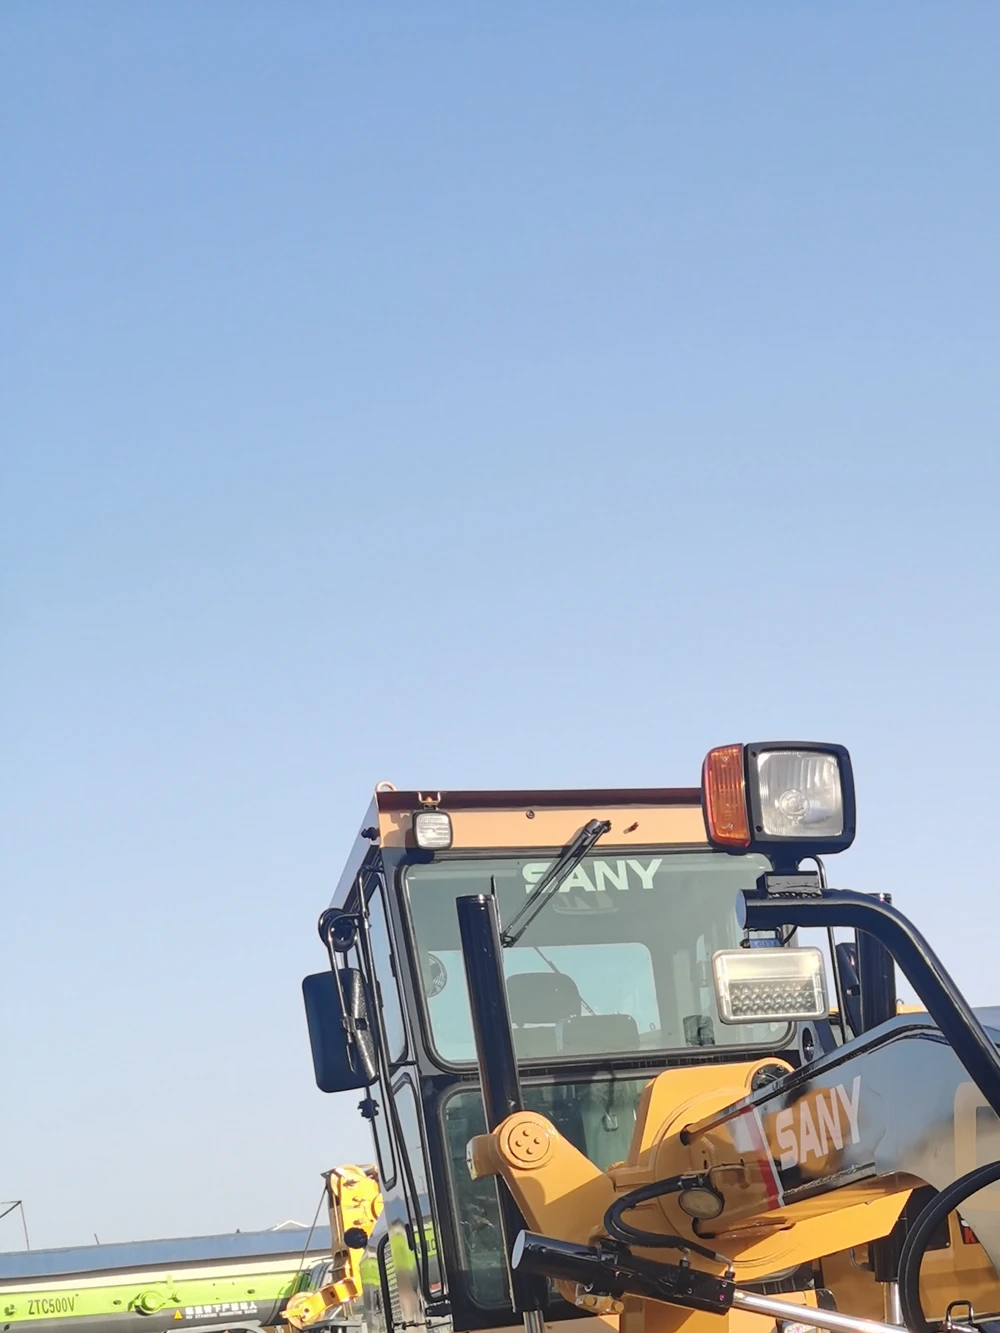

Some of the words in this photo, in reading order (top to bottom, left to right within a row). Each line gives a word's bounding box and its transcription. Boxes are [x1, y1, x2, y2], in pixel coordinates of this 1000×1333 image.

[522, 858, 663, 893] SANY
[775, 1076, 863, 1171] SANY
[27, 1297, 75, 1315] ZTC500V
